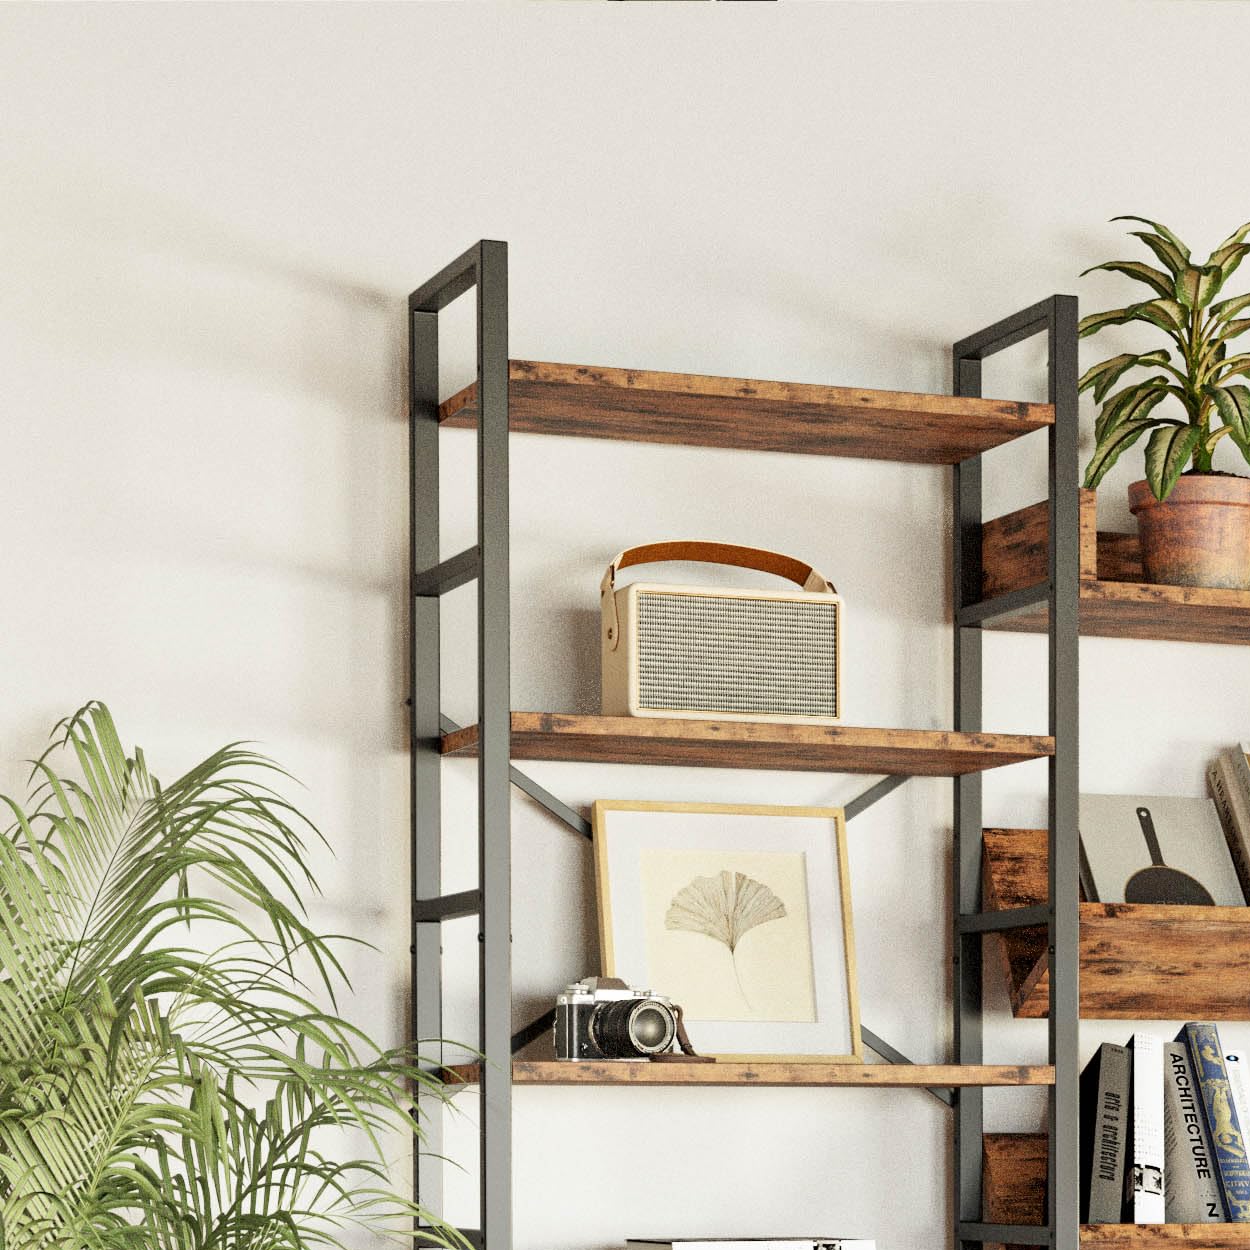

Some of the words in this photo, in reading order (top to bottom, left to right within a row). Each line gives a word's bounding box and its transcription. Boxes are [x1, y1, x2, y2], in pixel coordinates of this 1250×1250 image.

[1104, 1091, 1122, 1111] arts
[1169, 1053, 1211, 1180] ARCHITECTURE
[1099, 1124, 1121, 1181] architecture
[1206, 1202, 1219, 1217] N
